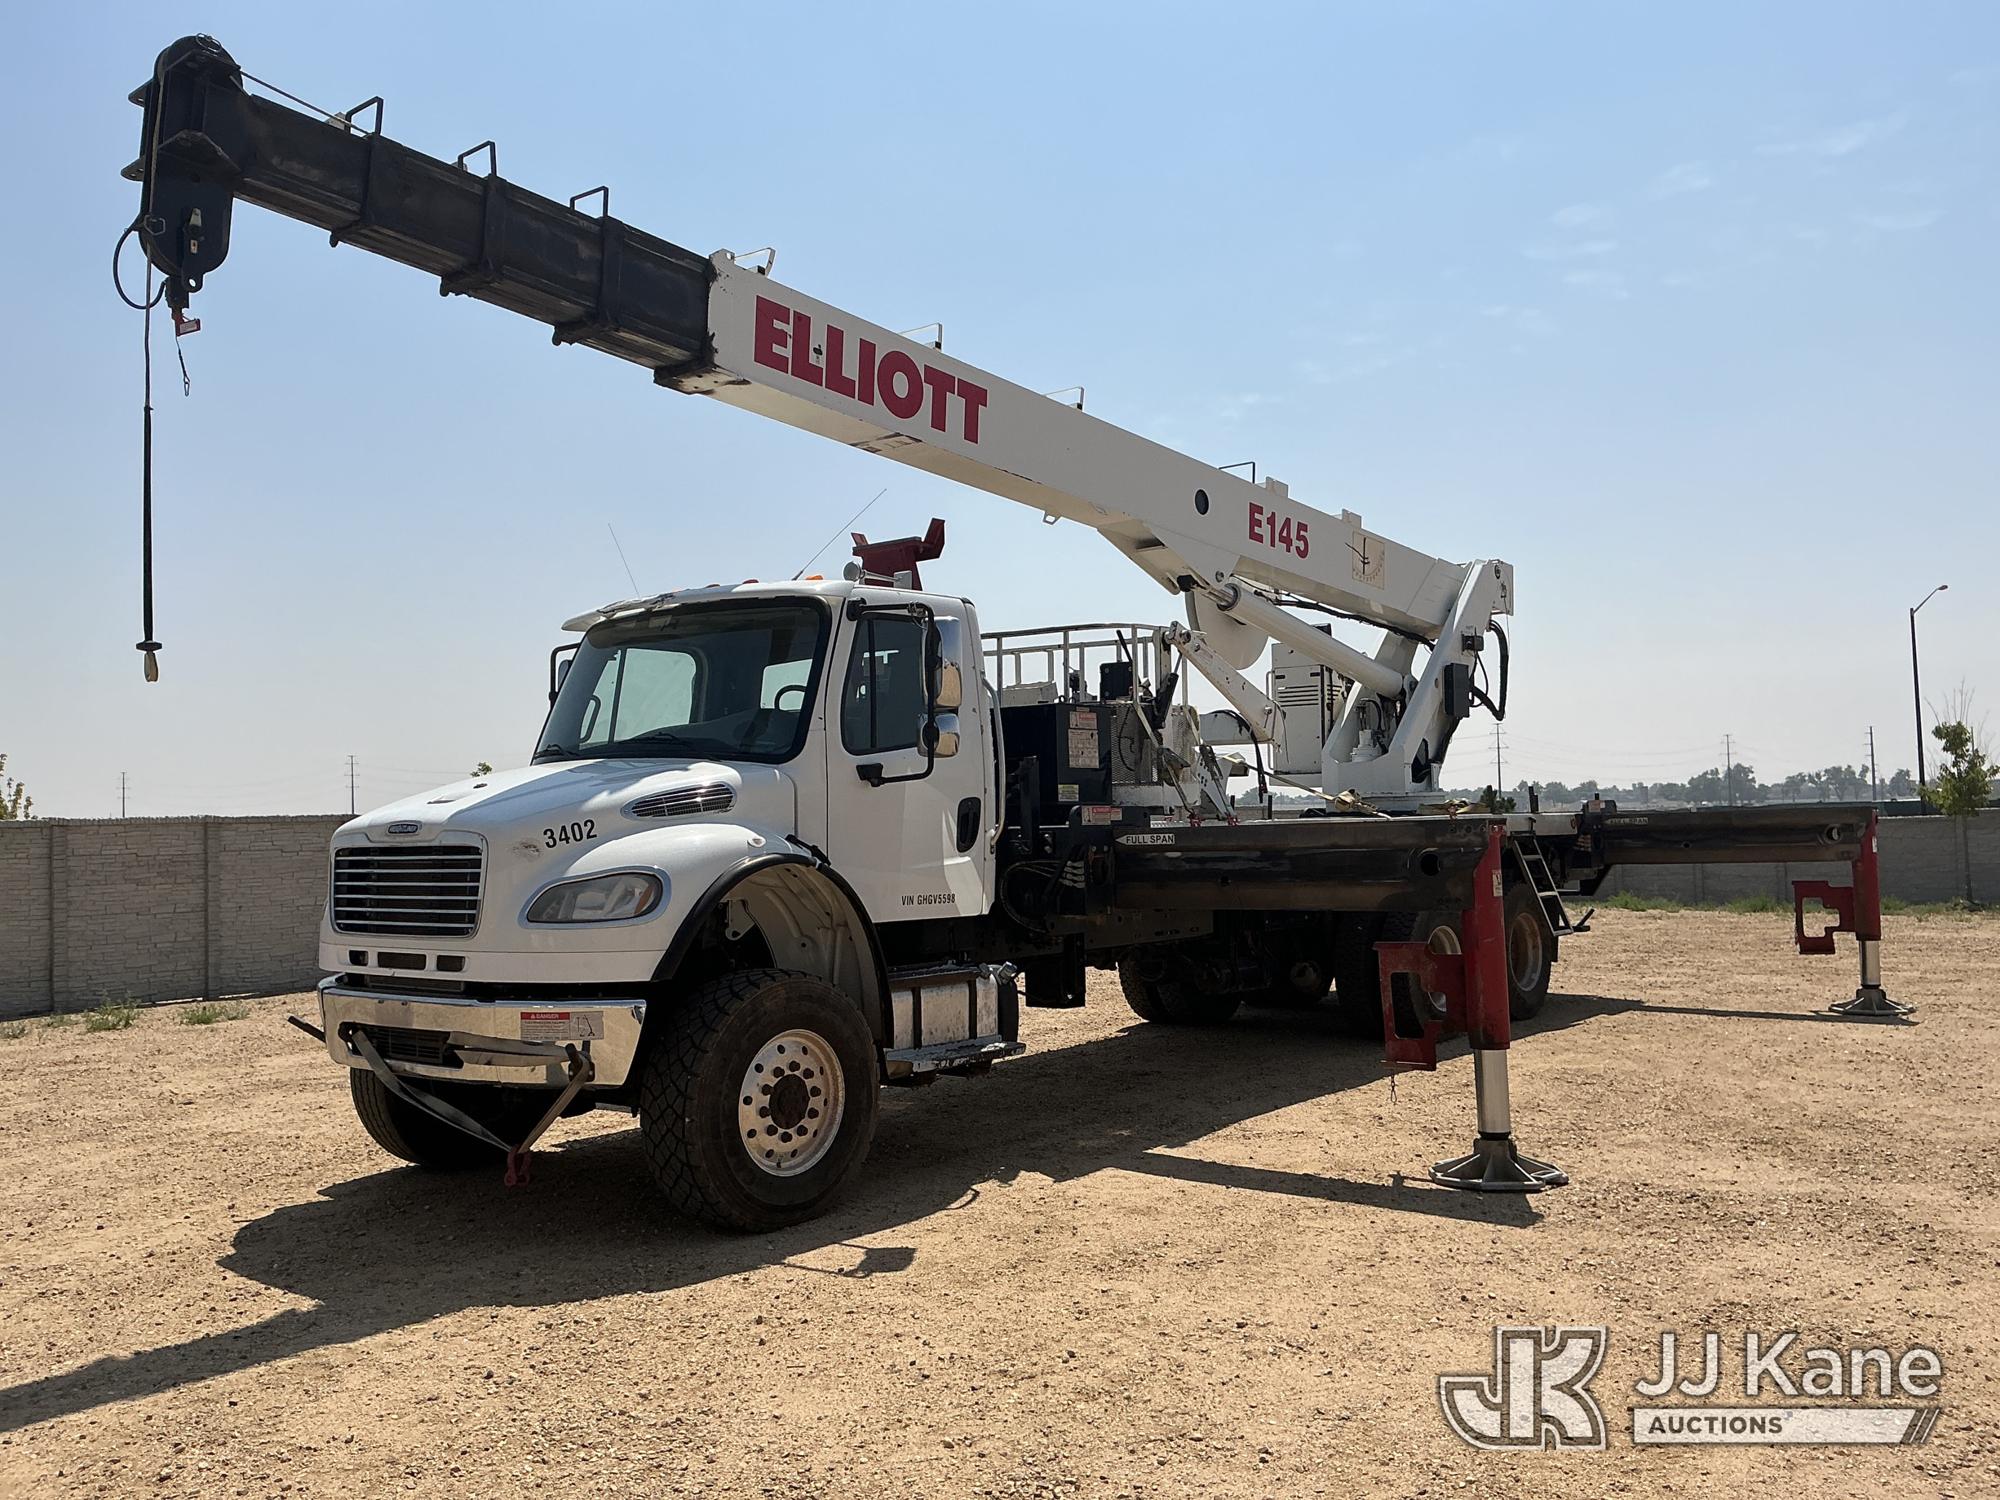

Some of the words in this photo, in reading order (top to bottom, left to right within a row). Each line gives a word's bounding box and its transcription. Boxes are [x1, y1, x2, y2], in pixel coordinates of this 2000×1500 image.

[754, 294, 988, 445] ELLIOTT
[1249, 502, 1309, 559] E145
[543, 819, 597, 848] 3402
[1126, 835, 1148, 844] FULL
[1150, 834, 1174, 844] SPAN
[901, 895, 914, 906] VIN
[917, 893, 956, 905] GHGV5598
